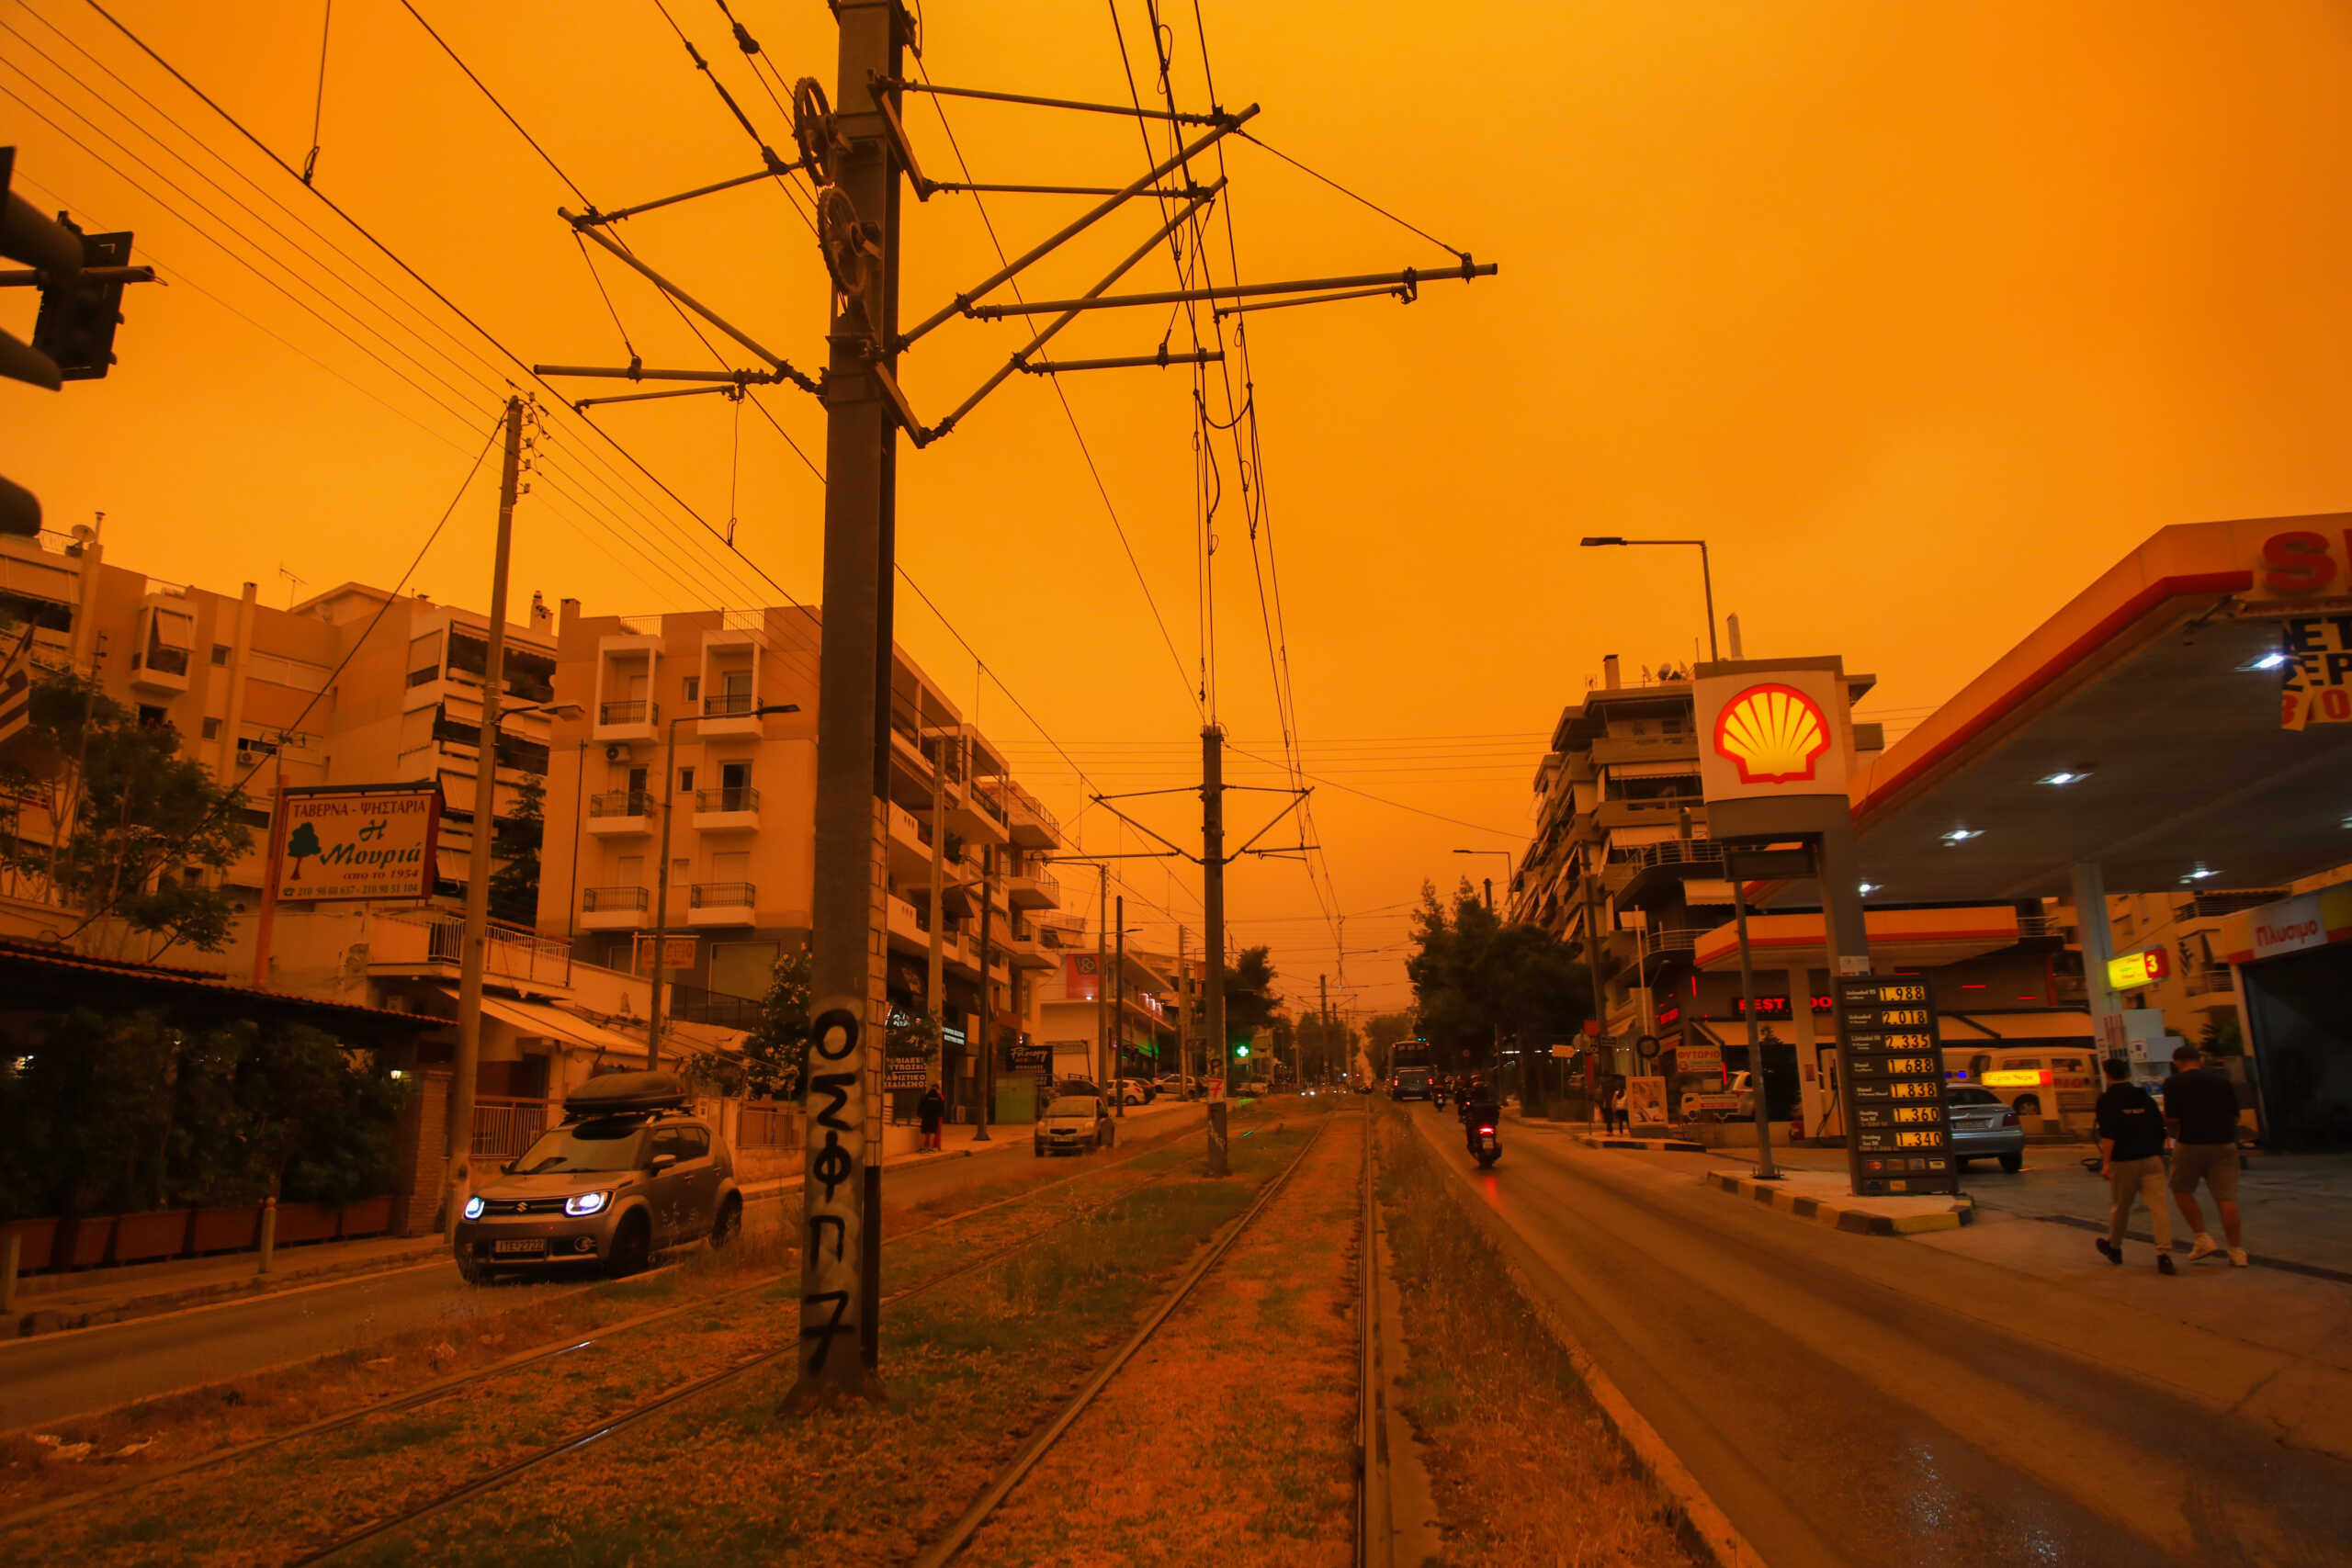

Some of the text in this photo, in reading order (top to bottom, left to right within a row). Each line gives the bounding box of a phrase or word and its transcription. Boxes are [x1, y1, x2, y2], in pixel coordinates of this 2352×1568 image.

[2262, 531, 2352, 592] S
[293, 803, 349, 818] ΤΑΒΕΡΝΑ
[360, 800, 426, 817] ΨΗΣΤΑΡΙΑ
[319, 841, 423, 870] Μουριά
[390, 868, 419, 879] 1954
[2146, 954, 2158, 973] 3
[1881, 987, 1925, 1001] 1.988
[1883, 1010, 1926, 1024] 2.018
[1885, 1034, 1928, 1049] 2.335
[1889, 1058, 1932, 1073] 1.688
[1207, 1079, 1224, 1099] 7
[1892, 1083, 1935, 1098] 1.838
[1895, 1107, 1939, 1122] 1.360
[1898, 1132, 1941, 1147] 1.340
